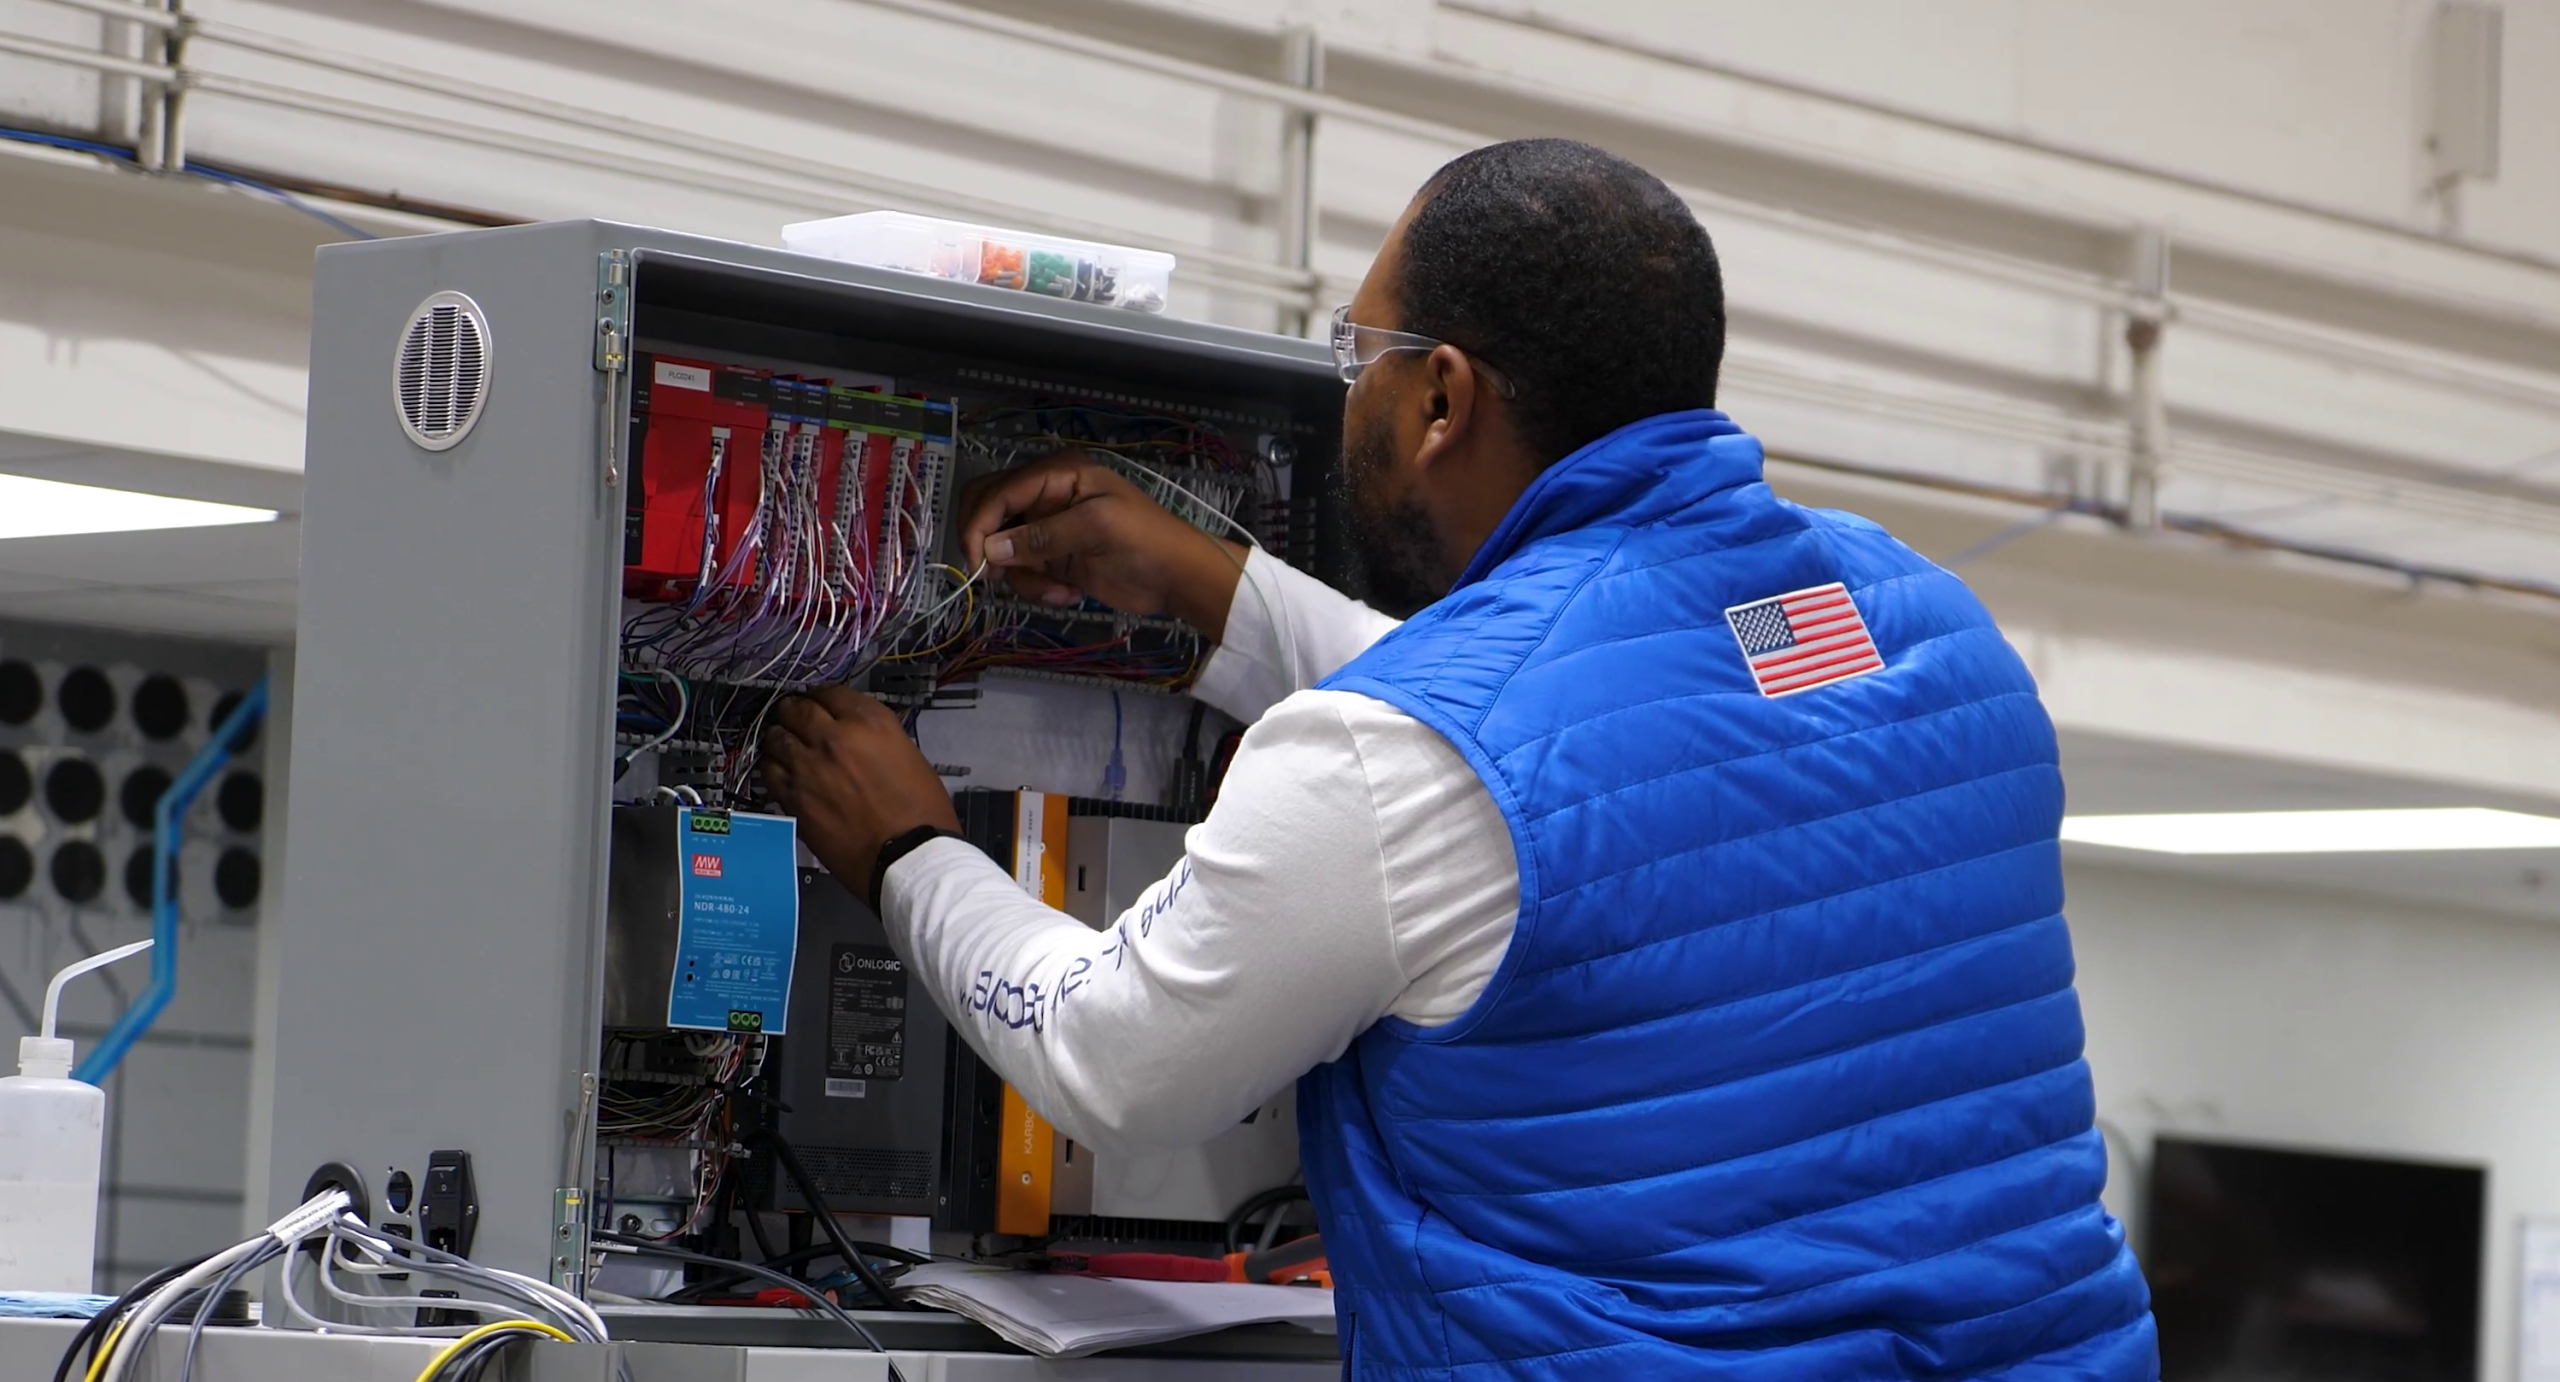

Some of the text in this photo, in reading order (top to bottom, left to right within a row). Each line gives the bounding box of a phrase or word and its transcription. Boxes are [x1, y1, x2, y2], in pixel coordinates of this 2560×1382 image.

[694, 855, 721, 870] MW
[694, 901, 750, 915] NDR-480-24
[857, 958, 901, 972] ONLOGIC
[1024, 1105, 1035, 1155] KARBO
